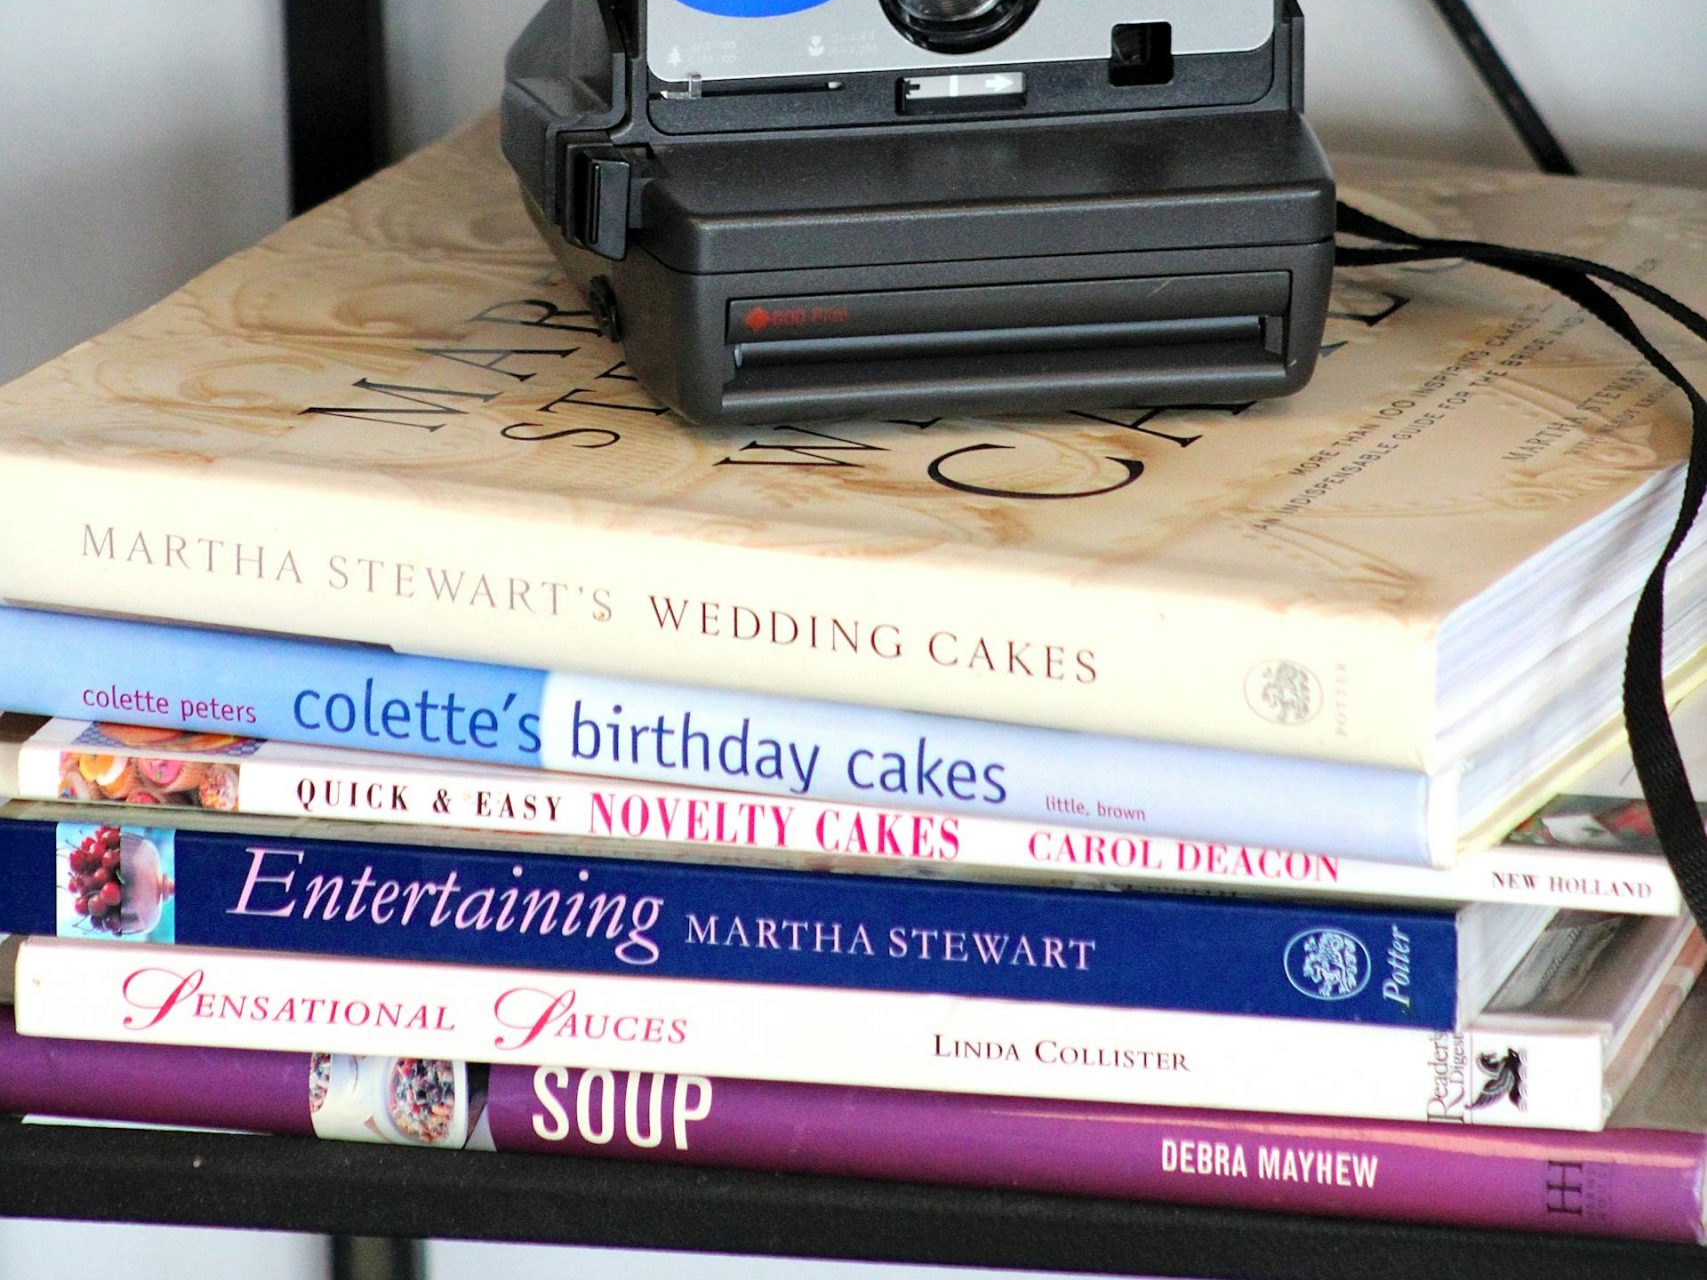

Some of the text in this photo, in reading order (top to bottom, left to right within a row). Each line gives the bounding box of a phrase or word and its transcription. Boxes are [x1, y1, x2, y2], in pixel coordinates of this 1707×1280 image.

[1275, 441, 1399, 515] INDISPENSABLE
[1391, 411, 1447, 441] GUIDE
[1437, 389, 1475, 411] FOR
[1467, 370, 1508, 388] THE
[1287, 450, 1340, 478] MORE
[1331, 422, 1381, 448] THAN
[1371, 399, 1416, 421] 100
[1501, 416, 1589, 463] MARTHA
[81, 523, 1098, 685] MARTHA STEWART'S WEDDING CAKES
[83, 685, 257, 724] colette peters
[293, 677, 1007, 806] colette's birthday cakes
[297, 778, 961, 861] QUICK & EASY NOVELTY CAKES
[1045, 795, 1147, 822] little, brown
[1028, 831, 1340, 884] CAROL DEACON
[1491, 871, 1653, 899] NEW HOLLAND
[226, 846, 665, 966] Entertaining
[685, 913, 1097, 971] MARTHA STEWART
[1382, 922, 1410, 1008] Potter
[121, 966, 688, 1050] SENSATIONAL SAUCES
[932, 1032, 1192, 1074] LINDA COLLISTER
[1450, 1031, 1468, 1086] Digest
[531, 1065, 713, 1151] SOUP
[1161, 1138, 1379, 1189] DEBRA MAYHEW
